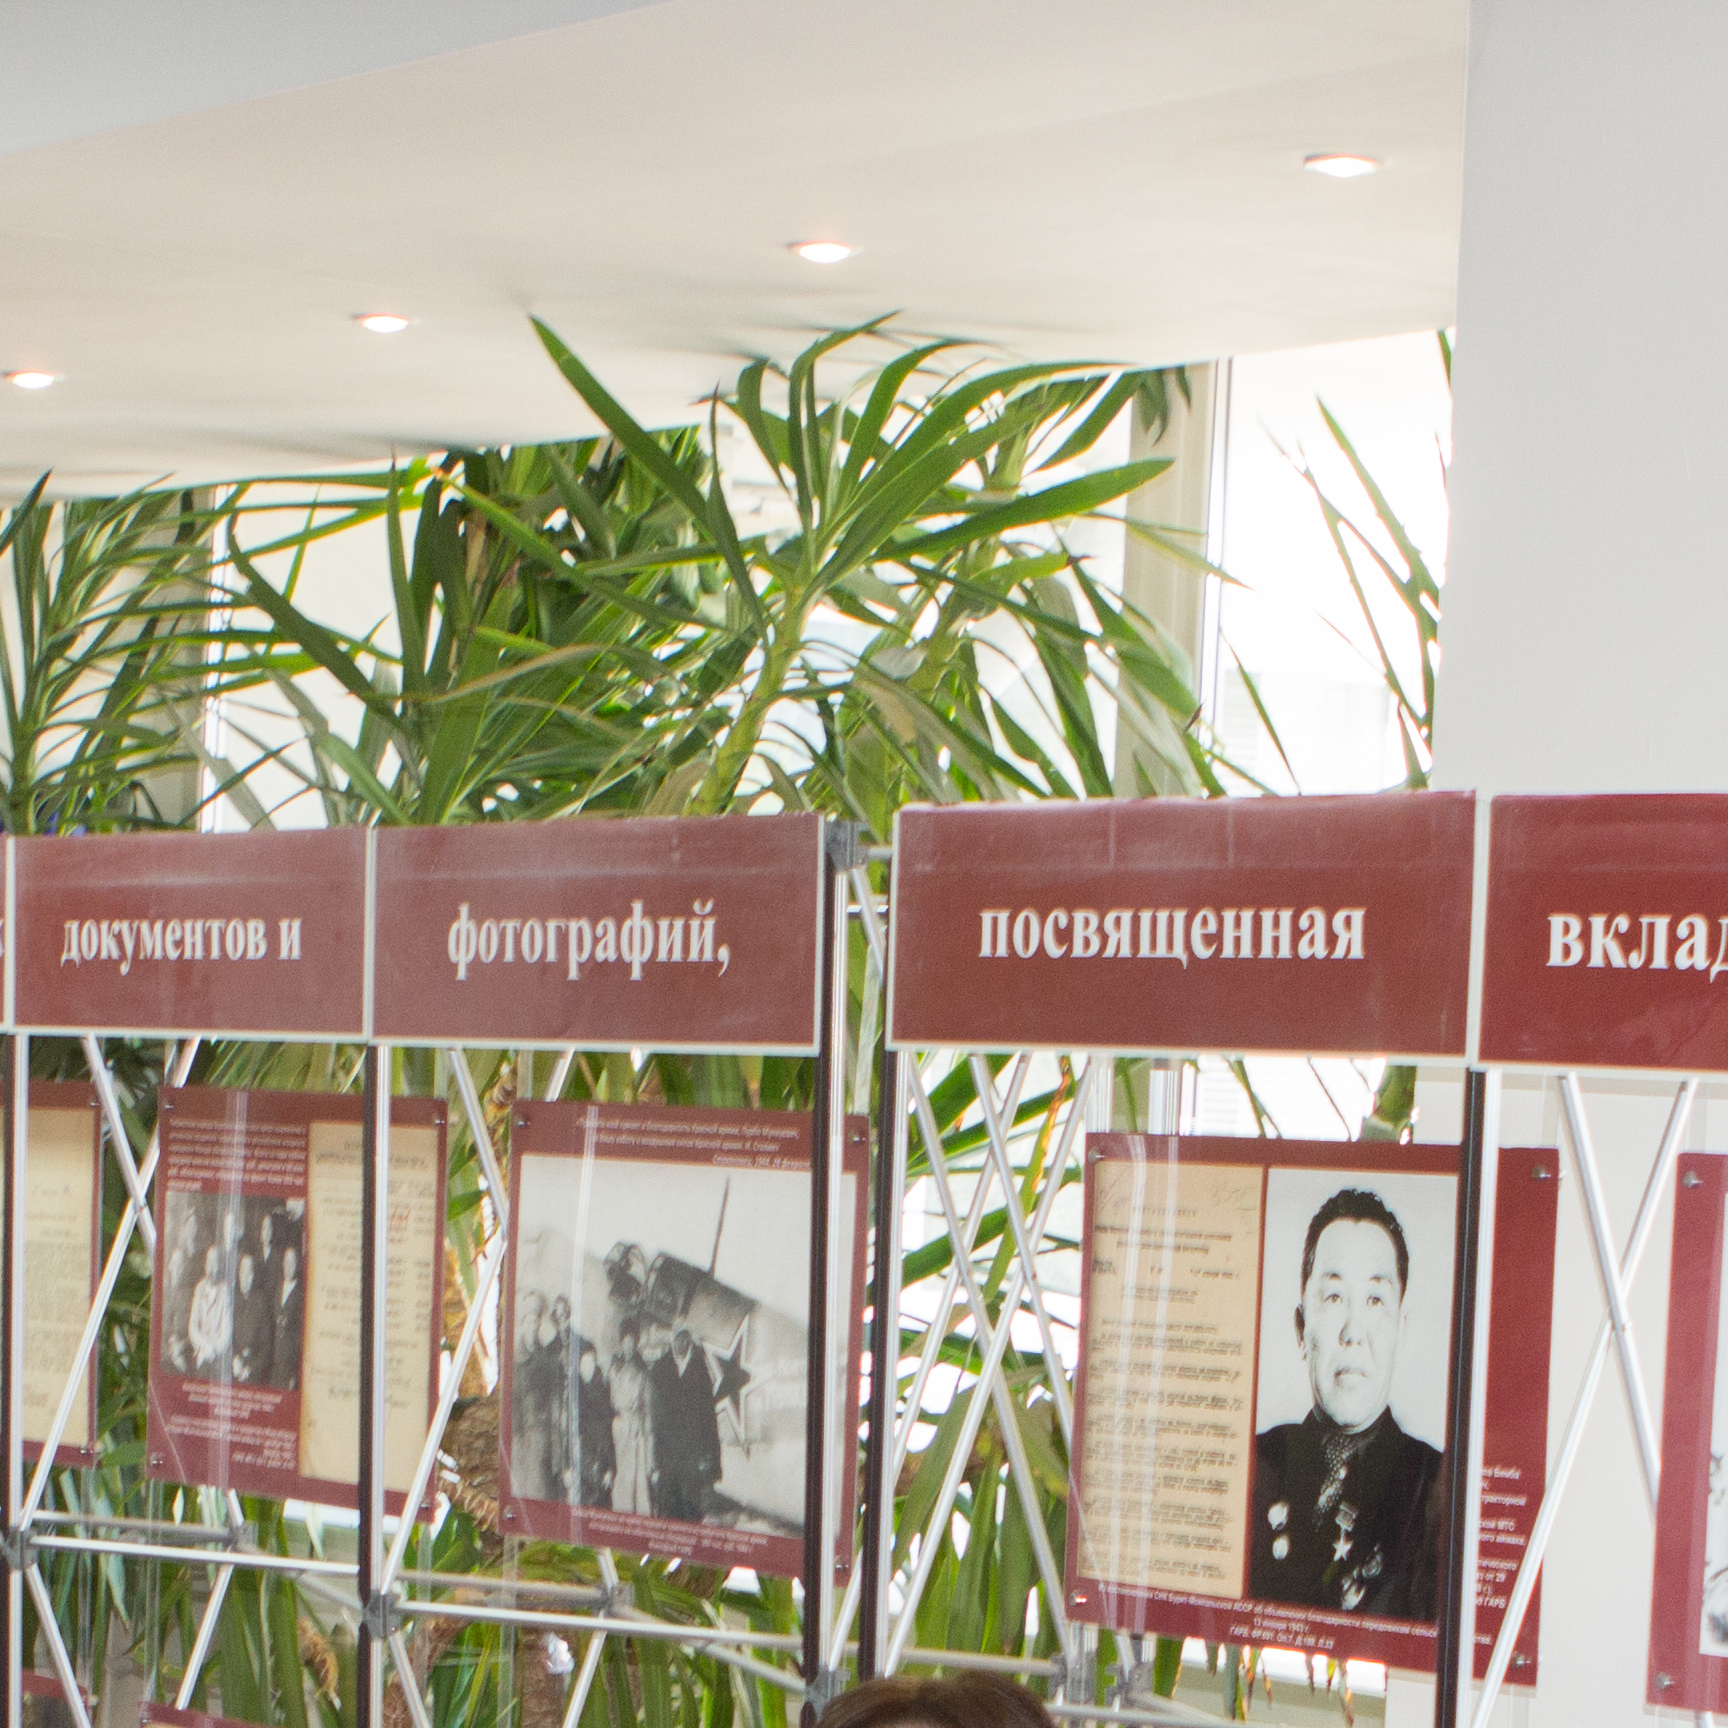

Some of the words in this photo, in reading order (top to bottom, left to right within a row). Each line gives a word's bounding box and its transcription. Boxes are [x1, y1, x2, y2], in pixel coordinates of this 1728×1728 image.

[60, 917, 267, 976] документов
[277, 918, 303, 960] и
[446, 899, 731, 981] фотографий,
[977, 905, 1367, 970] посвященная
